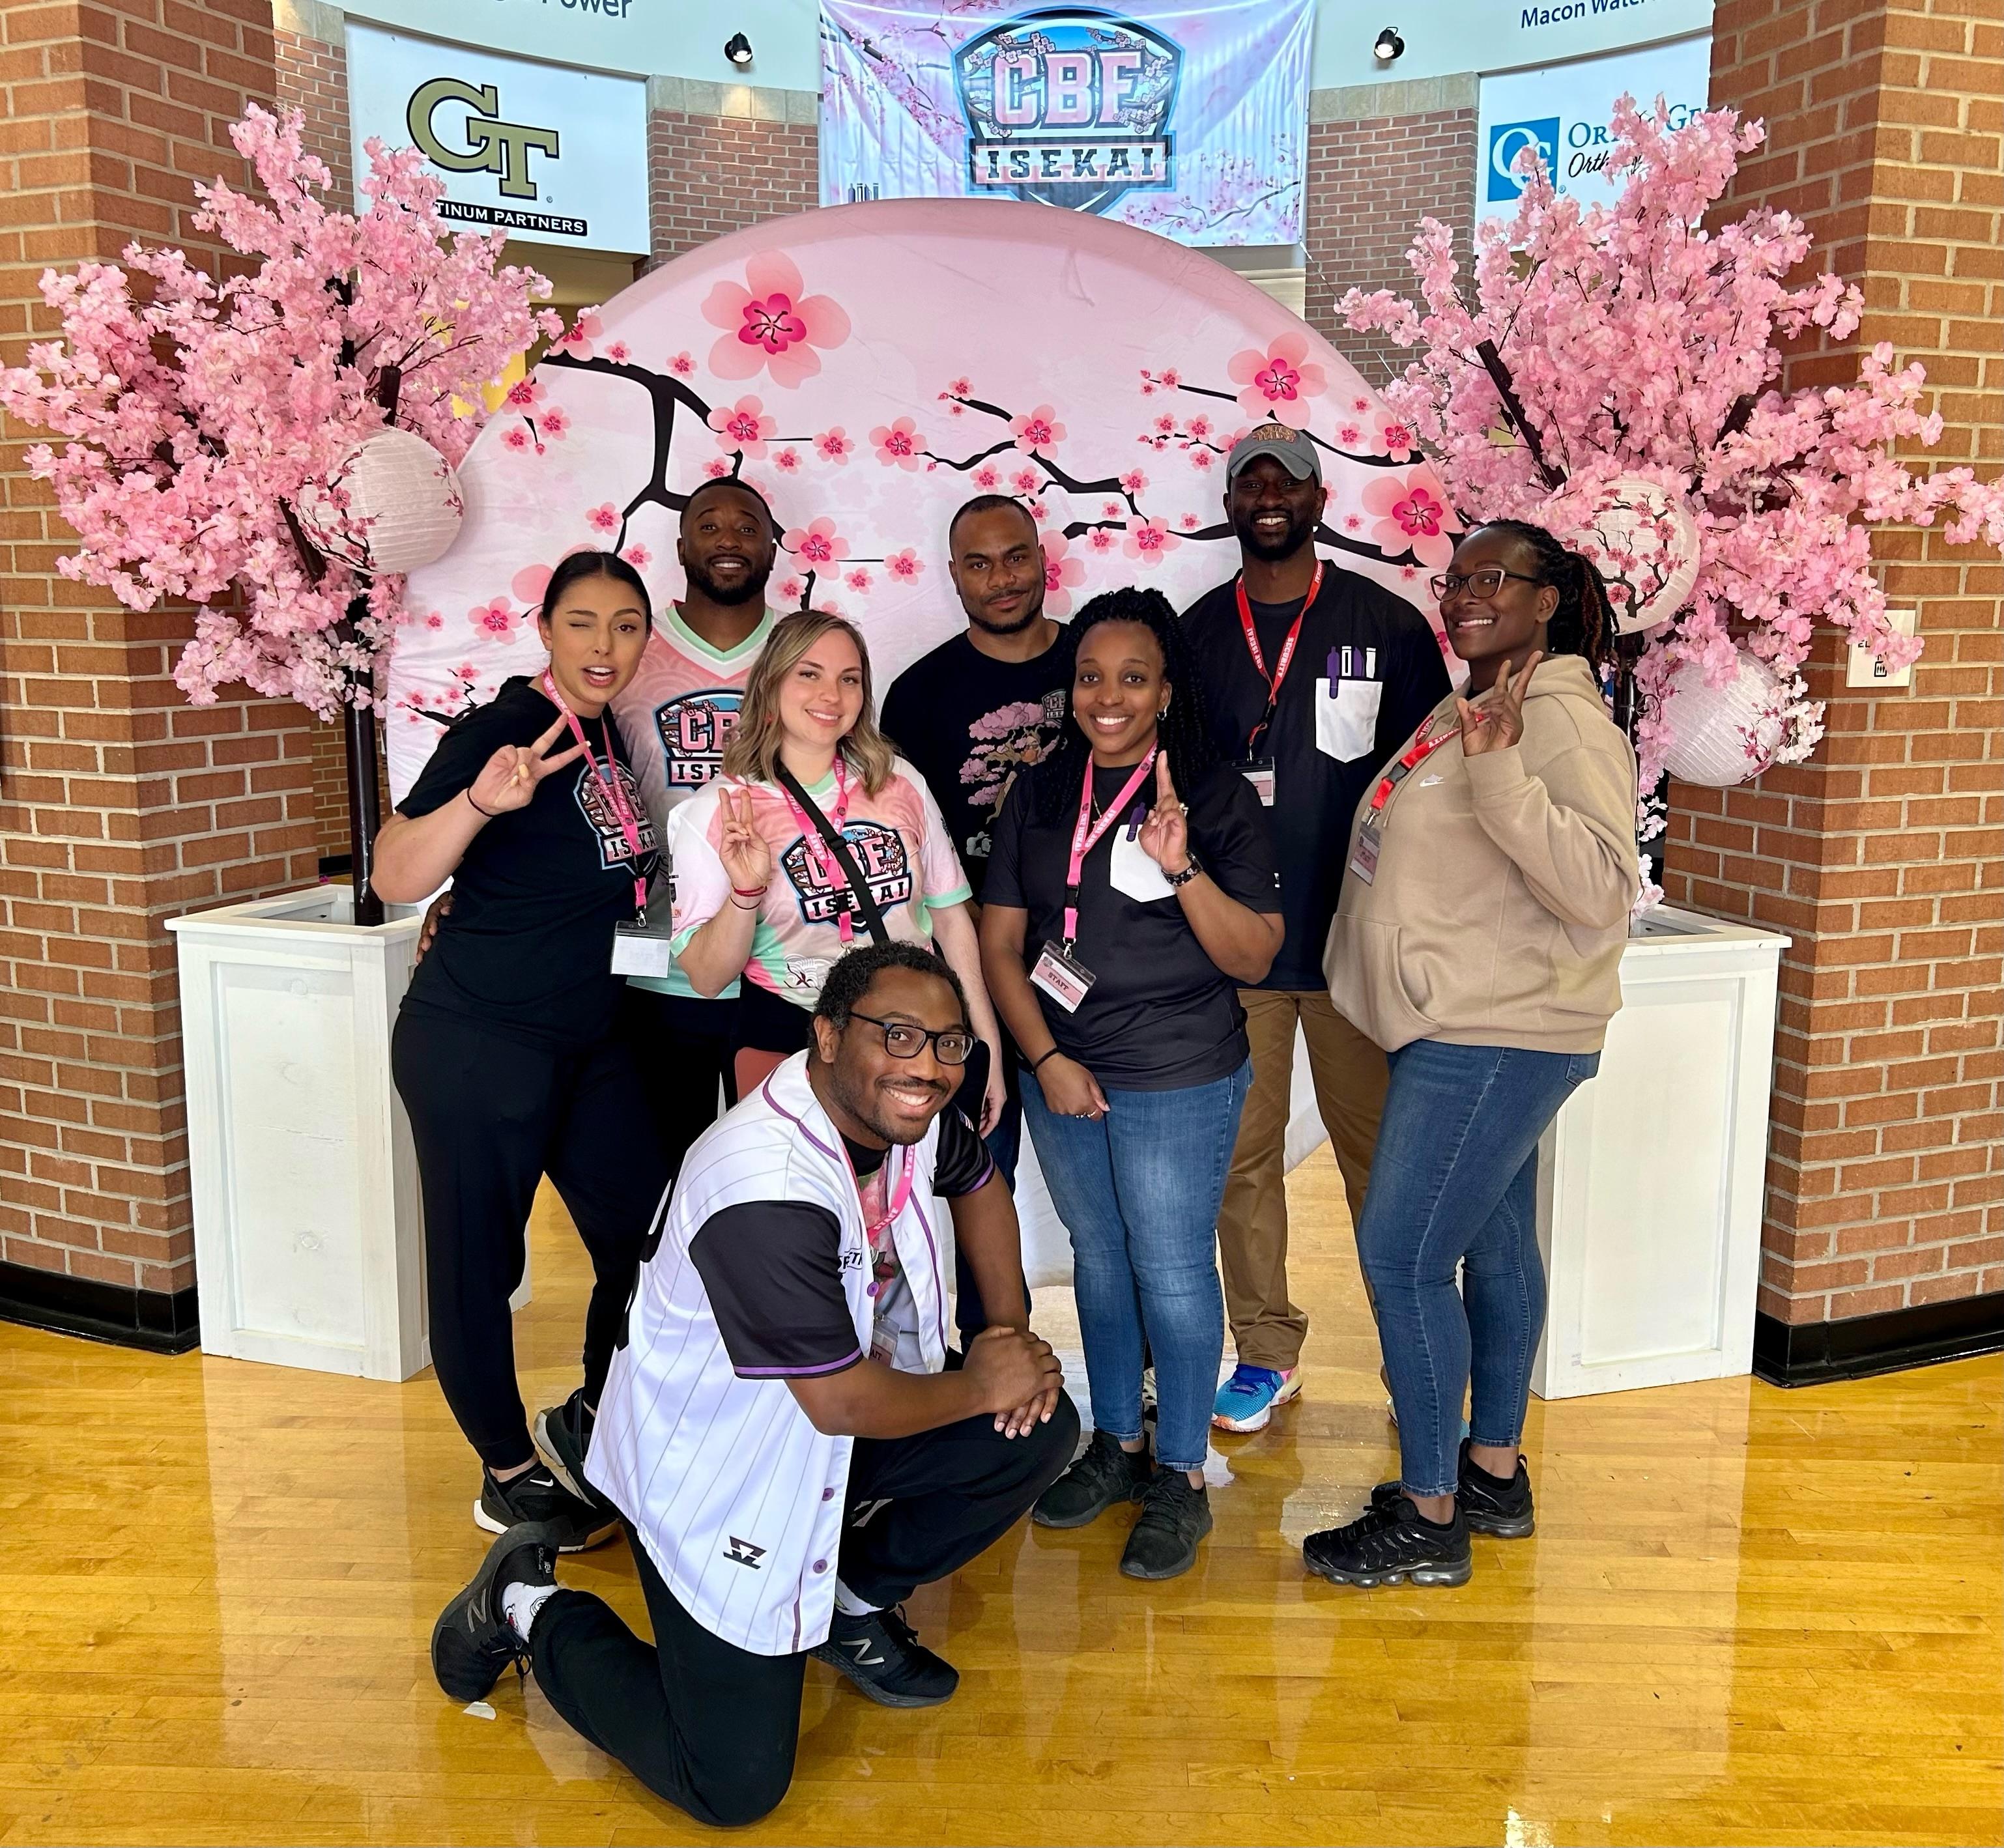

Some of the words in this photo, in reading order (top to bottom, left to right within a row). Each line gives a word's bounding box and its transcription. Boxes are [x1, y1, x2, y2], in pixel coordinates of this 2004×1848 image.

[542, 0, 633, 18] ower
[1521, 2, 1586, 29] Macon
[407, 78, 560, 201] GT
[987, 147, 1153, 179] ISEKAI
[435, 201, 488, 221] TINUM
[494, 210, 584, 233] PARTNERS
[1278, 637, 1295, 678] SECURITY
[680, 710, 741, 750] CB
[677, 763, 721, 780] ISE
[808, 834, 826, 860] STAFF
[812, 881, 905, 917] ISEAI
[1048, 972, 1069, 991] STAFF
[873, 1207, 899, 1230] STAFF
